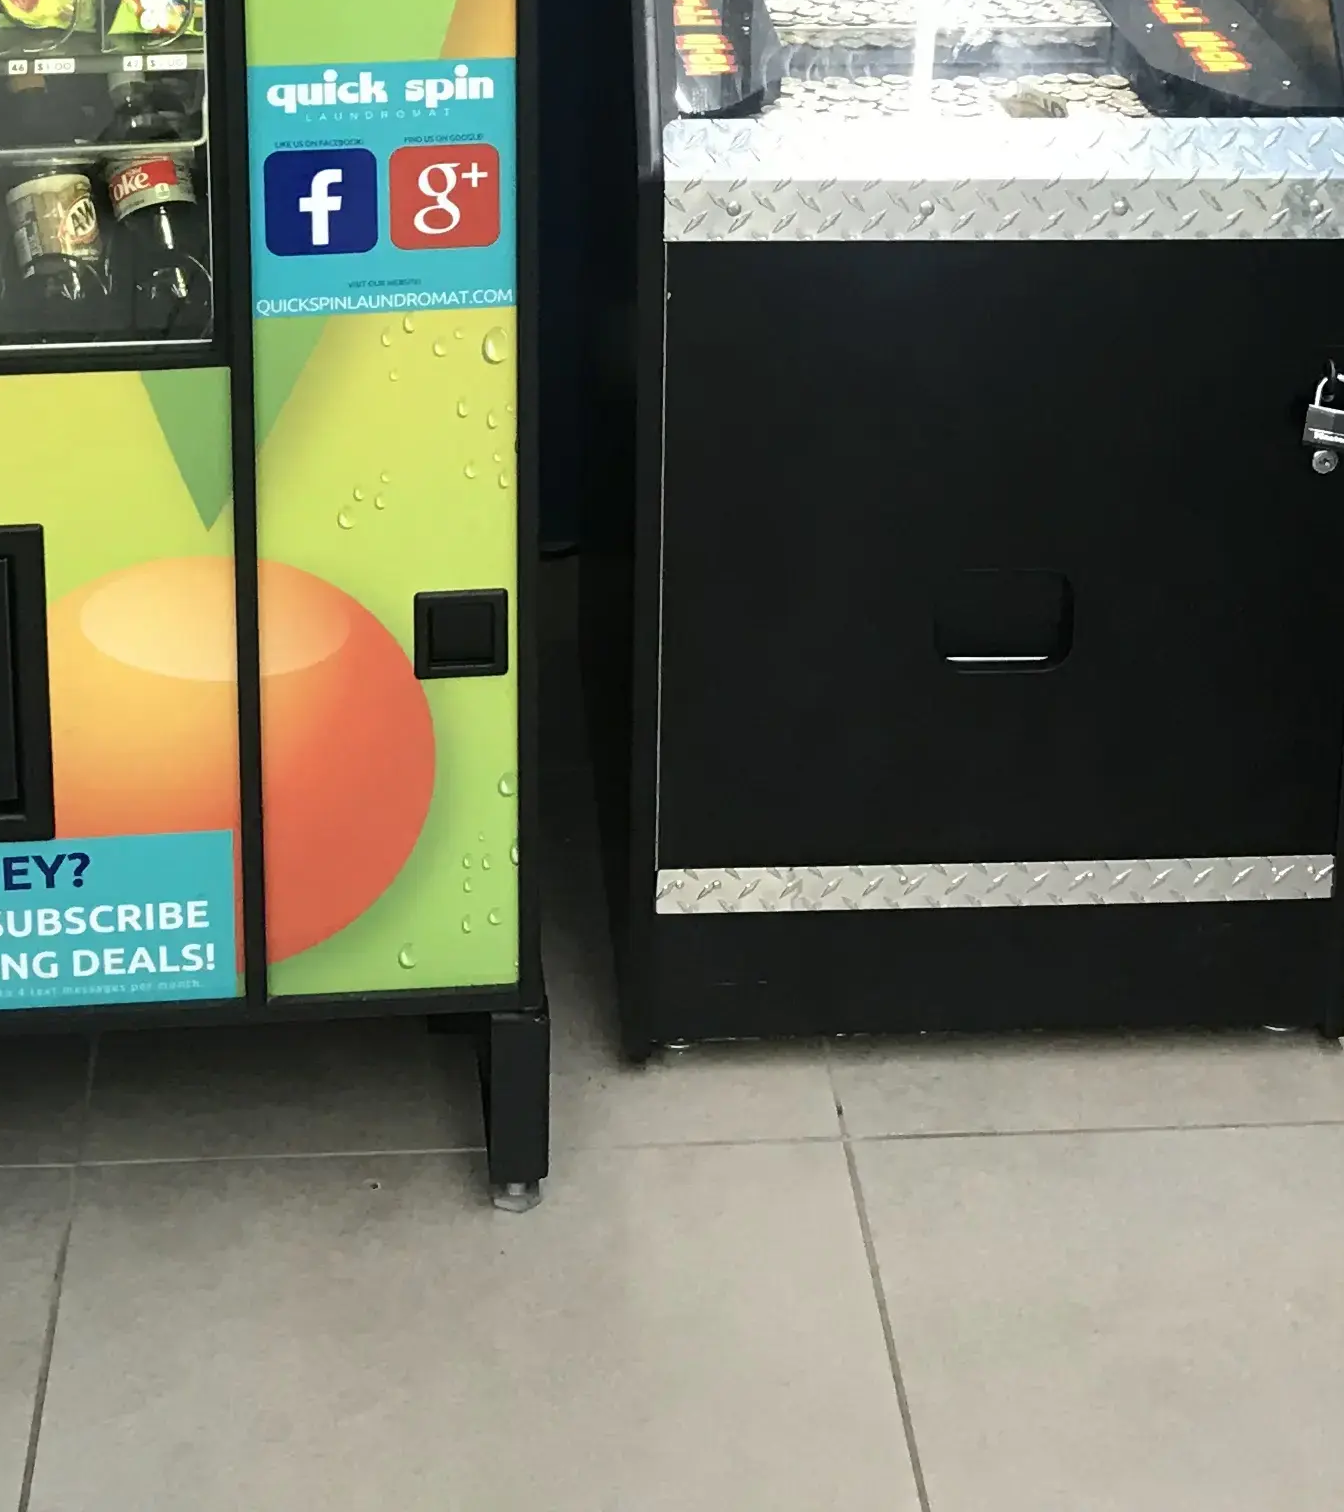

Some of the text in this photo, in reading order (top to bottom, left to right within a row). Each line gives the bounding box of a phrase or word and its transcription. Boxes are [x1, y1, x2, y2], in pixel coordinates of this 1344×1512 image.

[11, 63, 25, 72] 46
[266, 64, 495, 114] quick spin
[306, 108, 452, 122] LAUNDROMAT
[274, 141, 292, 149] LIKE
[293, 140, 305, 148] US
[306, 139, 318, 148] ON
[404, 136, 422, 144] FIND
[424, 135, 435, 143] US
[435, 134, 448, 143] ON
[111, 170, 151, 201] oke
[299, 169, 343, 246] f
[368, 279, 386, 288] OUR
[256, 288, 513, 317] QUICKSPINLAUNDROMAT.COM
[72, 943, 217, 978] DEALS!
[29, 986, 57, 998] text
[61, 983, 126, 998] messages
[130, 981, 153, 993] per
